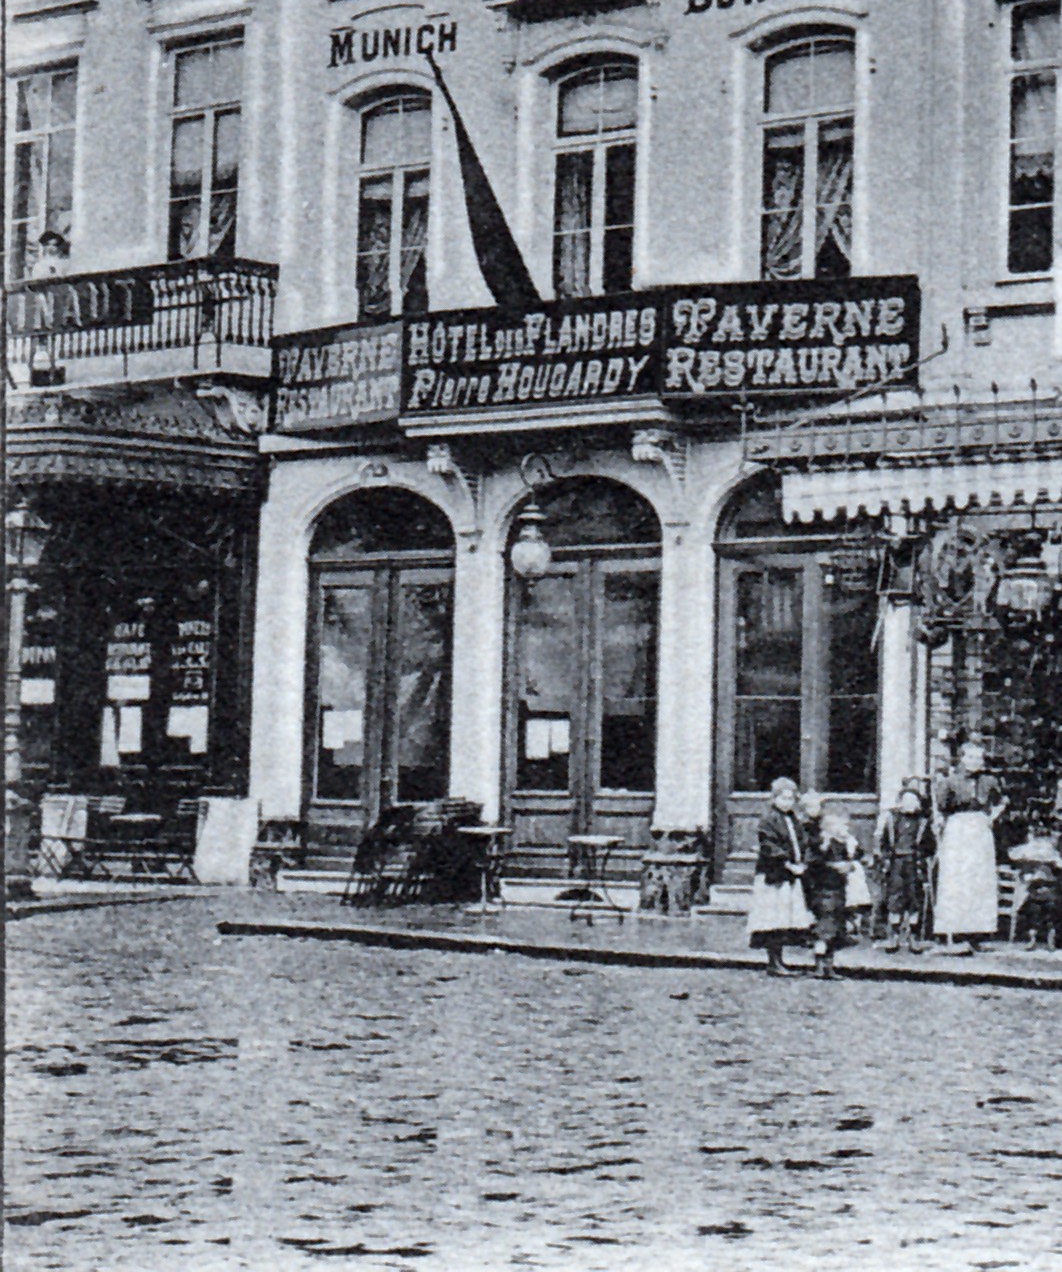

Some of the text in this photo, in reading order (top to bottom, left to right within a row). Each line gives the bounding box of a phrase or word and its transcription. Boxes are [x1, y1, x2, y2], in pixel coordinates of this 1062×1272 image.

[327, 21, 458, 69] MUNICH
[523, 306, 658, 356] FLANDRES
[672, 296, 906, 346] TAVERNE
[278, 332, 400, 385] TAVERNE
[665, 343, 911, 394] RESTAURANT
[407, 368, 492, 409] Pierre
